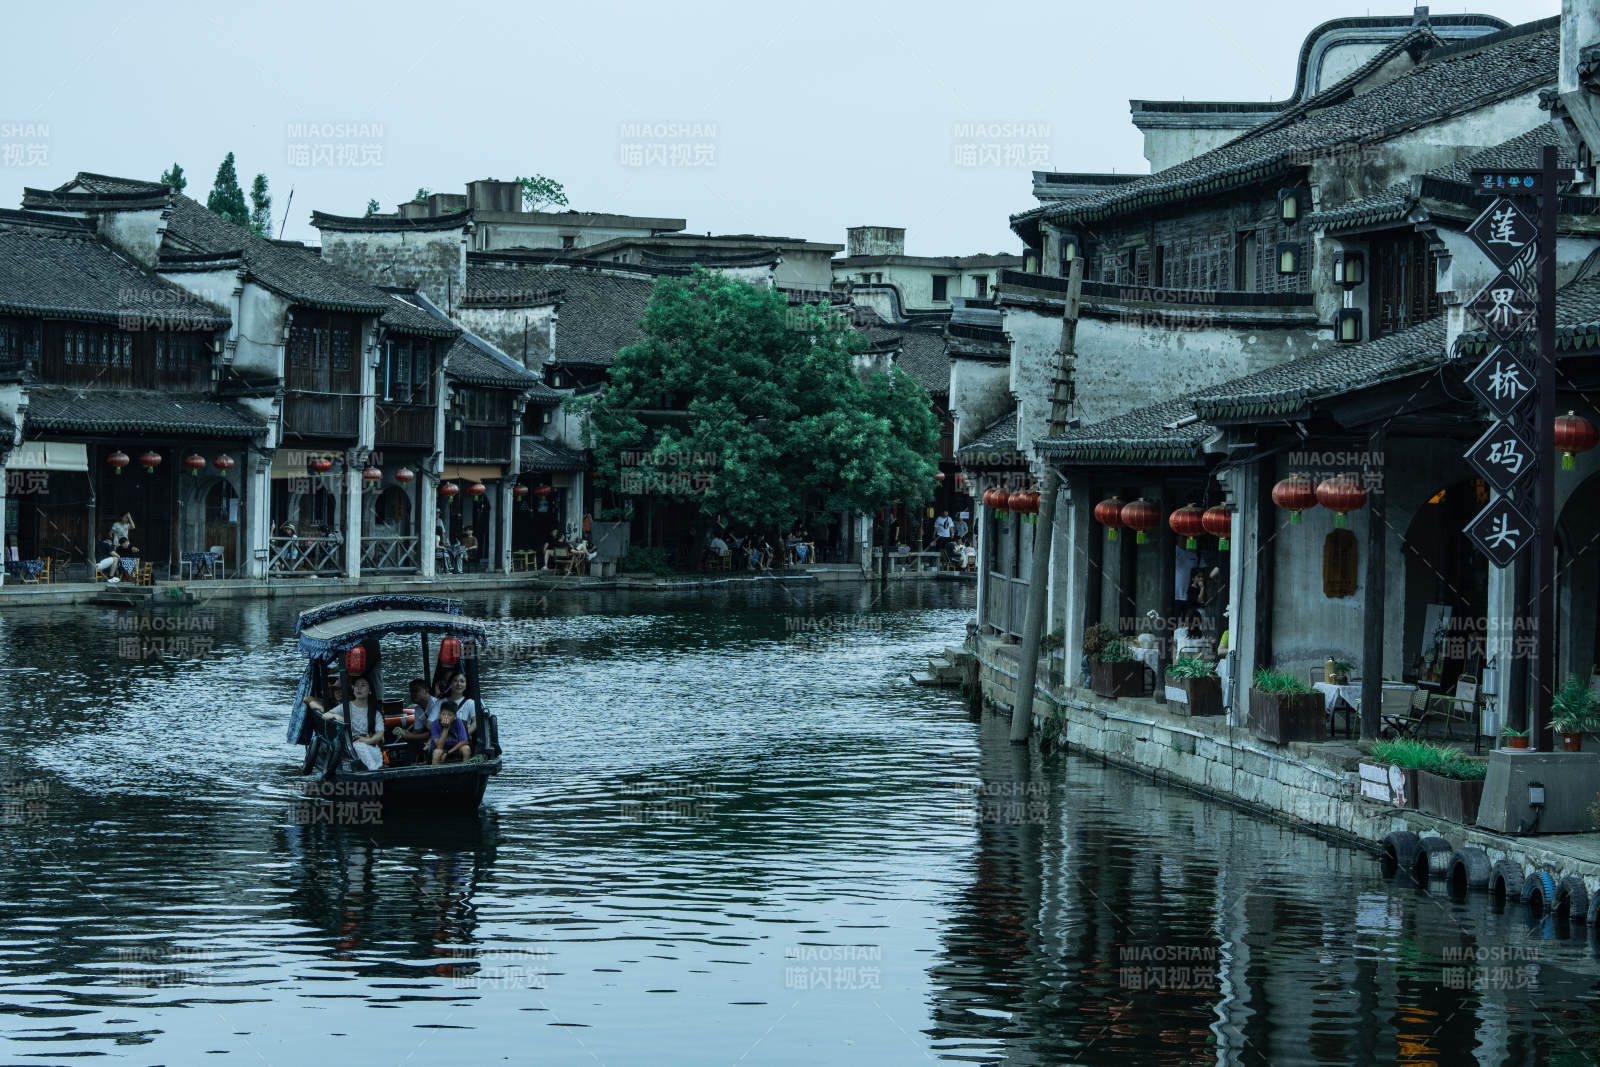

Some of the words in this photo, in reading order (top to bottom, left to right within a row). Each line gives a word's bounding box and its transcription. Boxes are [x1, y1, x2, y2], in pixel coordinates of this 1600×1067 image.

[1485, 207, 1528, 550] 莲界桥码头
